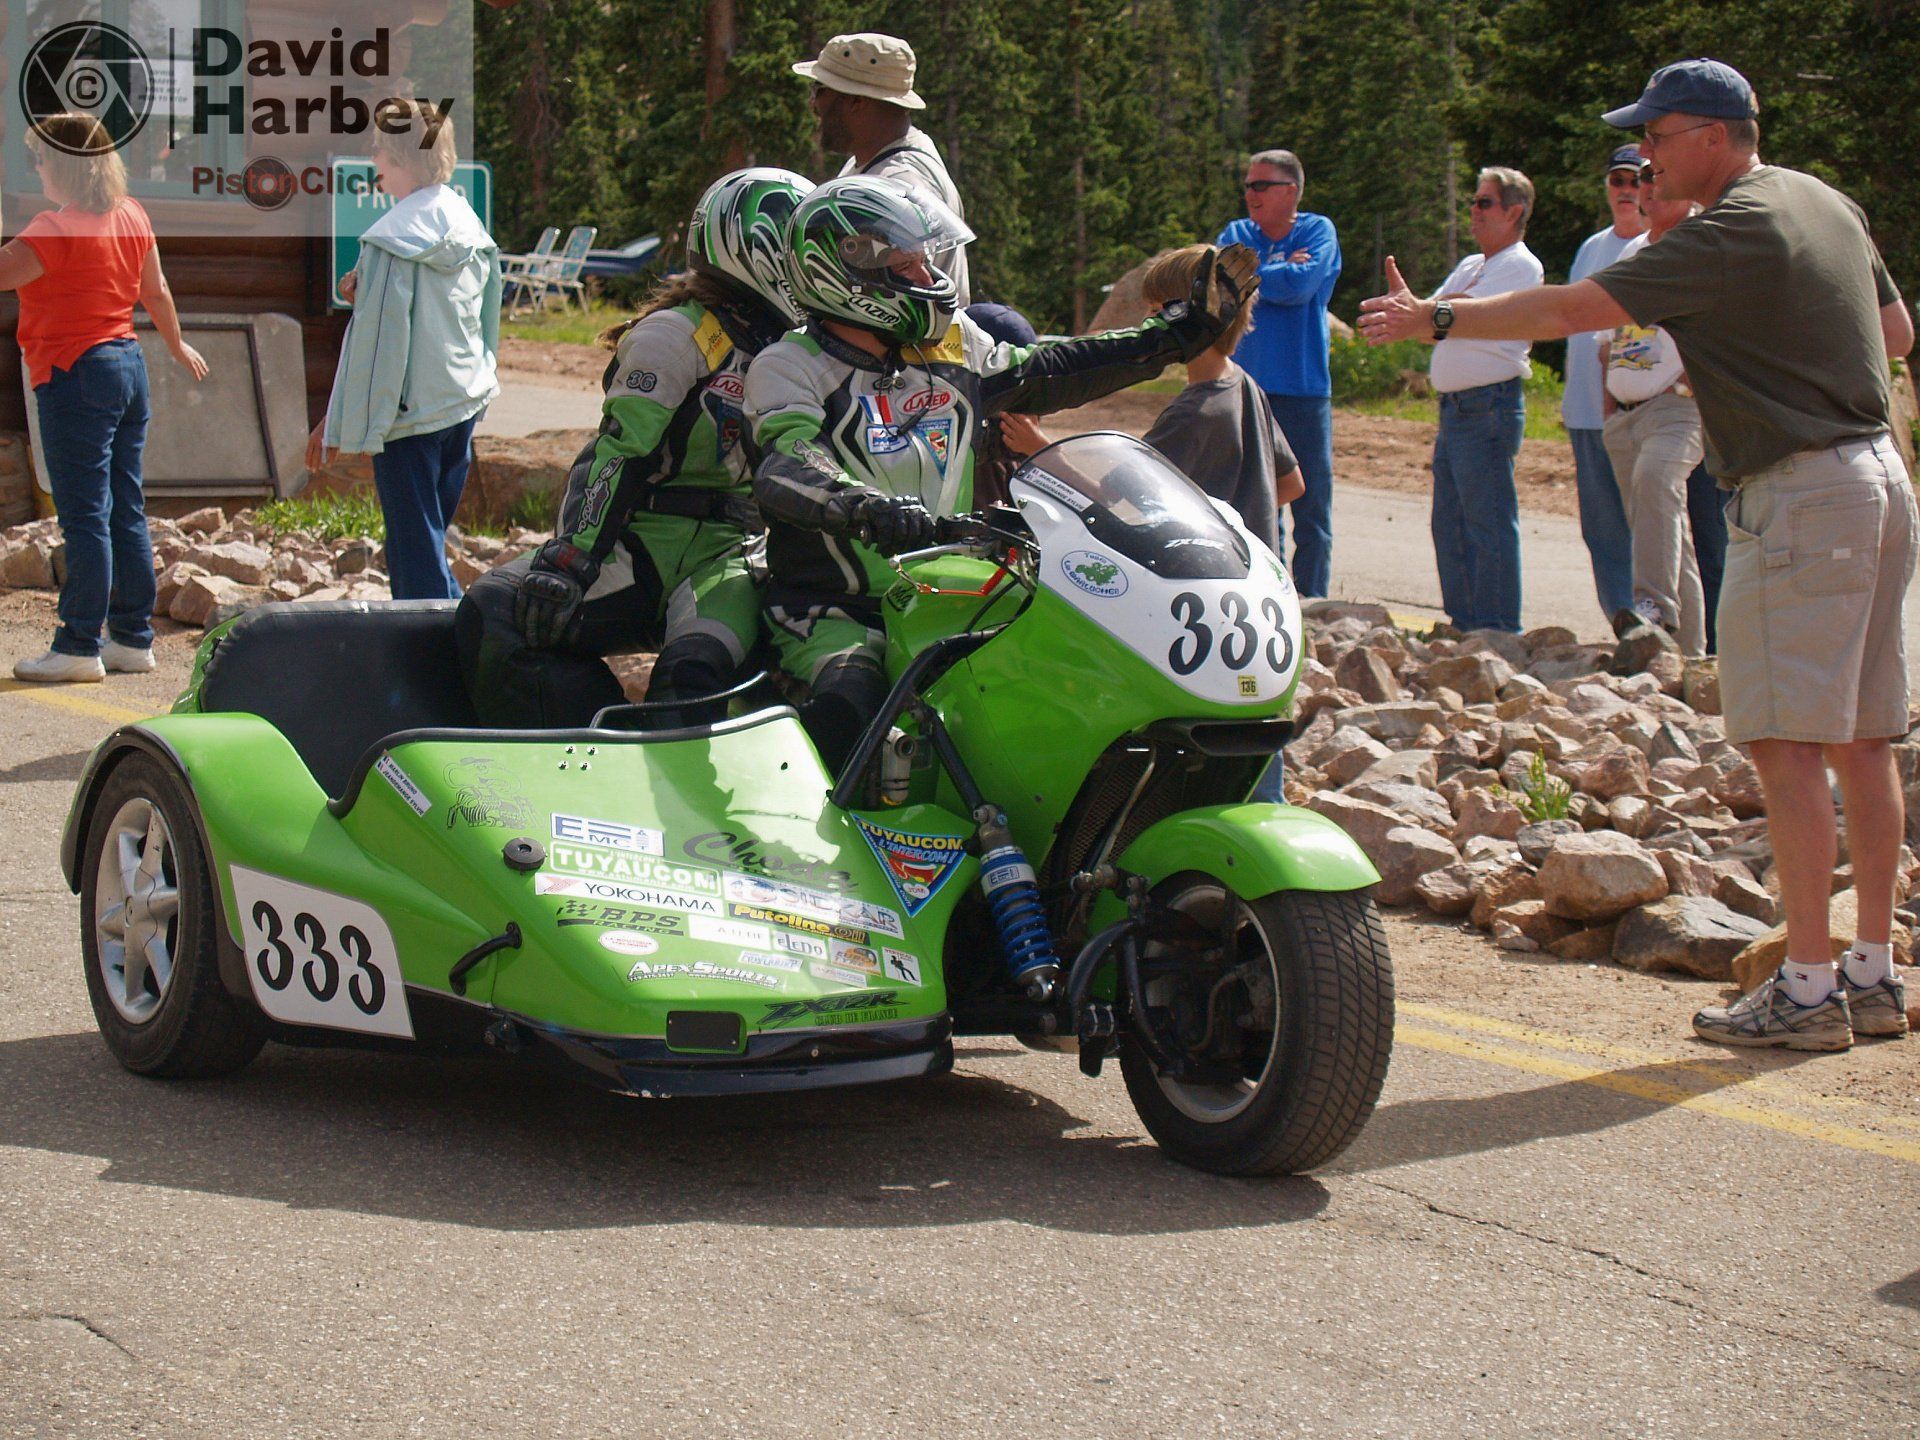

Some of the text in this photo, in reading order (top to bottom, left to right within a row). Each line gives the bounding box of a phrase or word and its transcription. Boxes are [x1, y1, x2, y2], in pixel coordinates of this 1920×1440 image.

[856, 295, 898, 324] LAZER
[626, 369, 657, 393] 36
[712, 379, 744, 395] LAZE
[908, 391, 951, 410] LAZER
[1168, 592, 1293, 676] 333
[1241, 681, 1256, 693] 136
[861, 821, 963, 851] TUYAUCOM
[555, 848, 716, 890] TUYAUCOM
[585, 882, 716, 912] YOKOHAMA
[599, 908, 681, 928] BPS
[734, 904, 832, 934] Putoline
[252, 900, 386, 1016] 333
